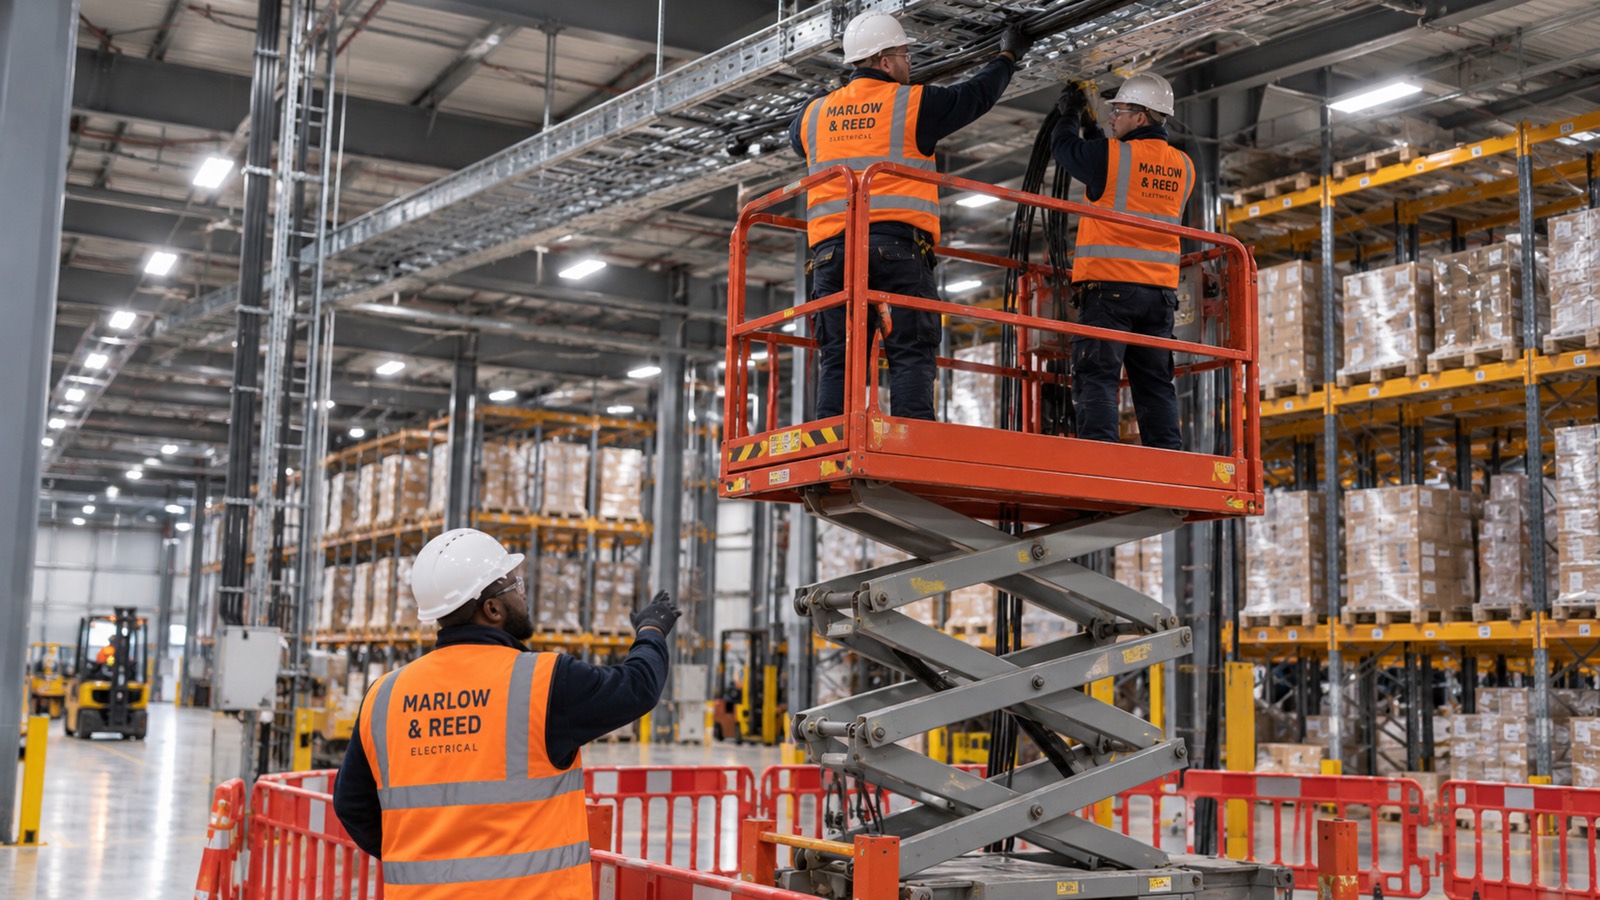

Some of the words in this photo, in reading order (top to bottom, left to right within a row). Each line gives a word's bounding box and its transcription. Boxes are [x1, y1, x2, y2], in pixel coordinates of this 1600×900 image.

[827, 102, 883, 117] MARLOW
[829, 120, 838, 132] &
[841, 117, 876, 130] REED
[1138, 162, 1182, 178] MARLOW
[1141, 177, 1149, 188] &
[1152, 178, 1179, 192] REED
[403, 688, 491, 713] MARLOW
[408, 719, 422, 739] &
[429, 715, 481, 737] REED
[411, 743, 478, 756] ELECTRICAL
